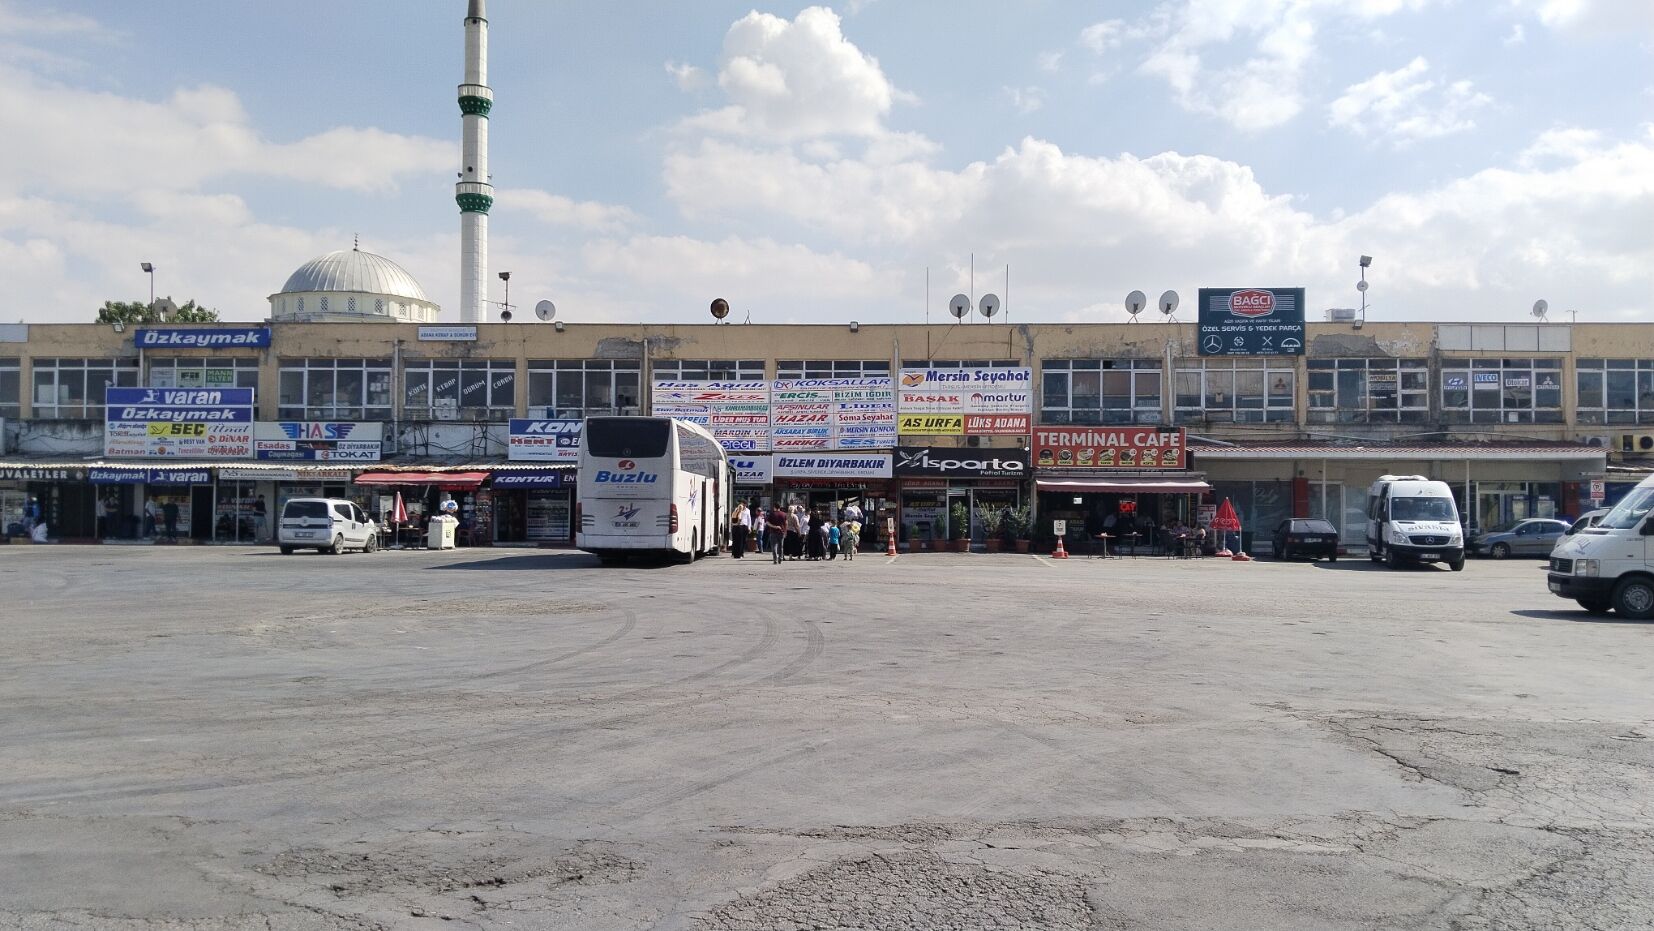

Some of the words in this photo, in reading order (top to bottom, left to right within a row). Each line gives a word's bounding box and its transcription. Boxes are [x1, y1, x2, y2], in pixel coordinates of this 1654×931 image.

[1233, 293, 1271, 306] BAĞCI
[1221, 324, 1246, 332] SERVİS
[143, 330, 261, 347] Özkaymak
[925, 370, 971, 382] Mersin
[974, 369, 1030, 384] Seyahat
[164, 391, 222, 405] varan
[983, 392, 1027, 402] martur
[121, 407, 237, 421] Özkaymak
[775, 414, 828, 422] HAZAR
[862, 413, 894, 422] Seyahat
[525, 422, 584, 433] KON
[925, 418, 962, 428] URFA
[967, 416, 992, 428] LÜKS
[993, 417, 1027, 428] ADANA
[1037, 429, 1130, 447] TERMİNAL
[1133, 432, 1181, 447] CAFE
[332, 451, 377, 459] TOKAT
[778, 457, 815, 468] ÖZLEM
[816, 457, 885, 469] DİYARBAKIR
[922, 455, 1024, 471] Isparta
[90, 470, 146, 481] Özkaymak
[169, 471, 209, 482] varan
[494, 475, 555, 483] KONTUR
[594, 470, 658, 483] Buzlu
